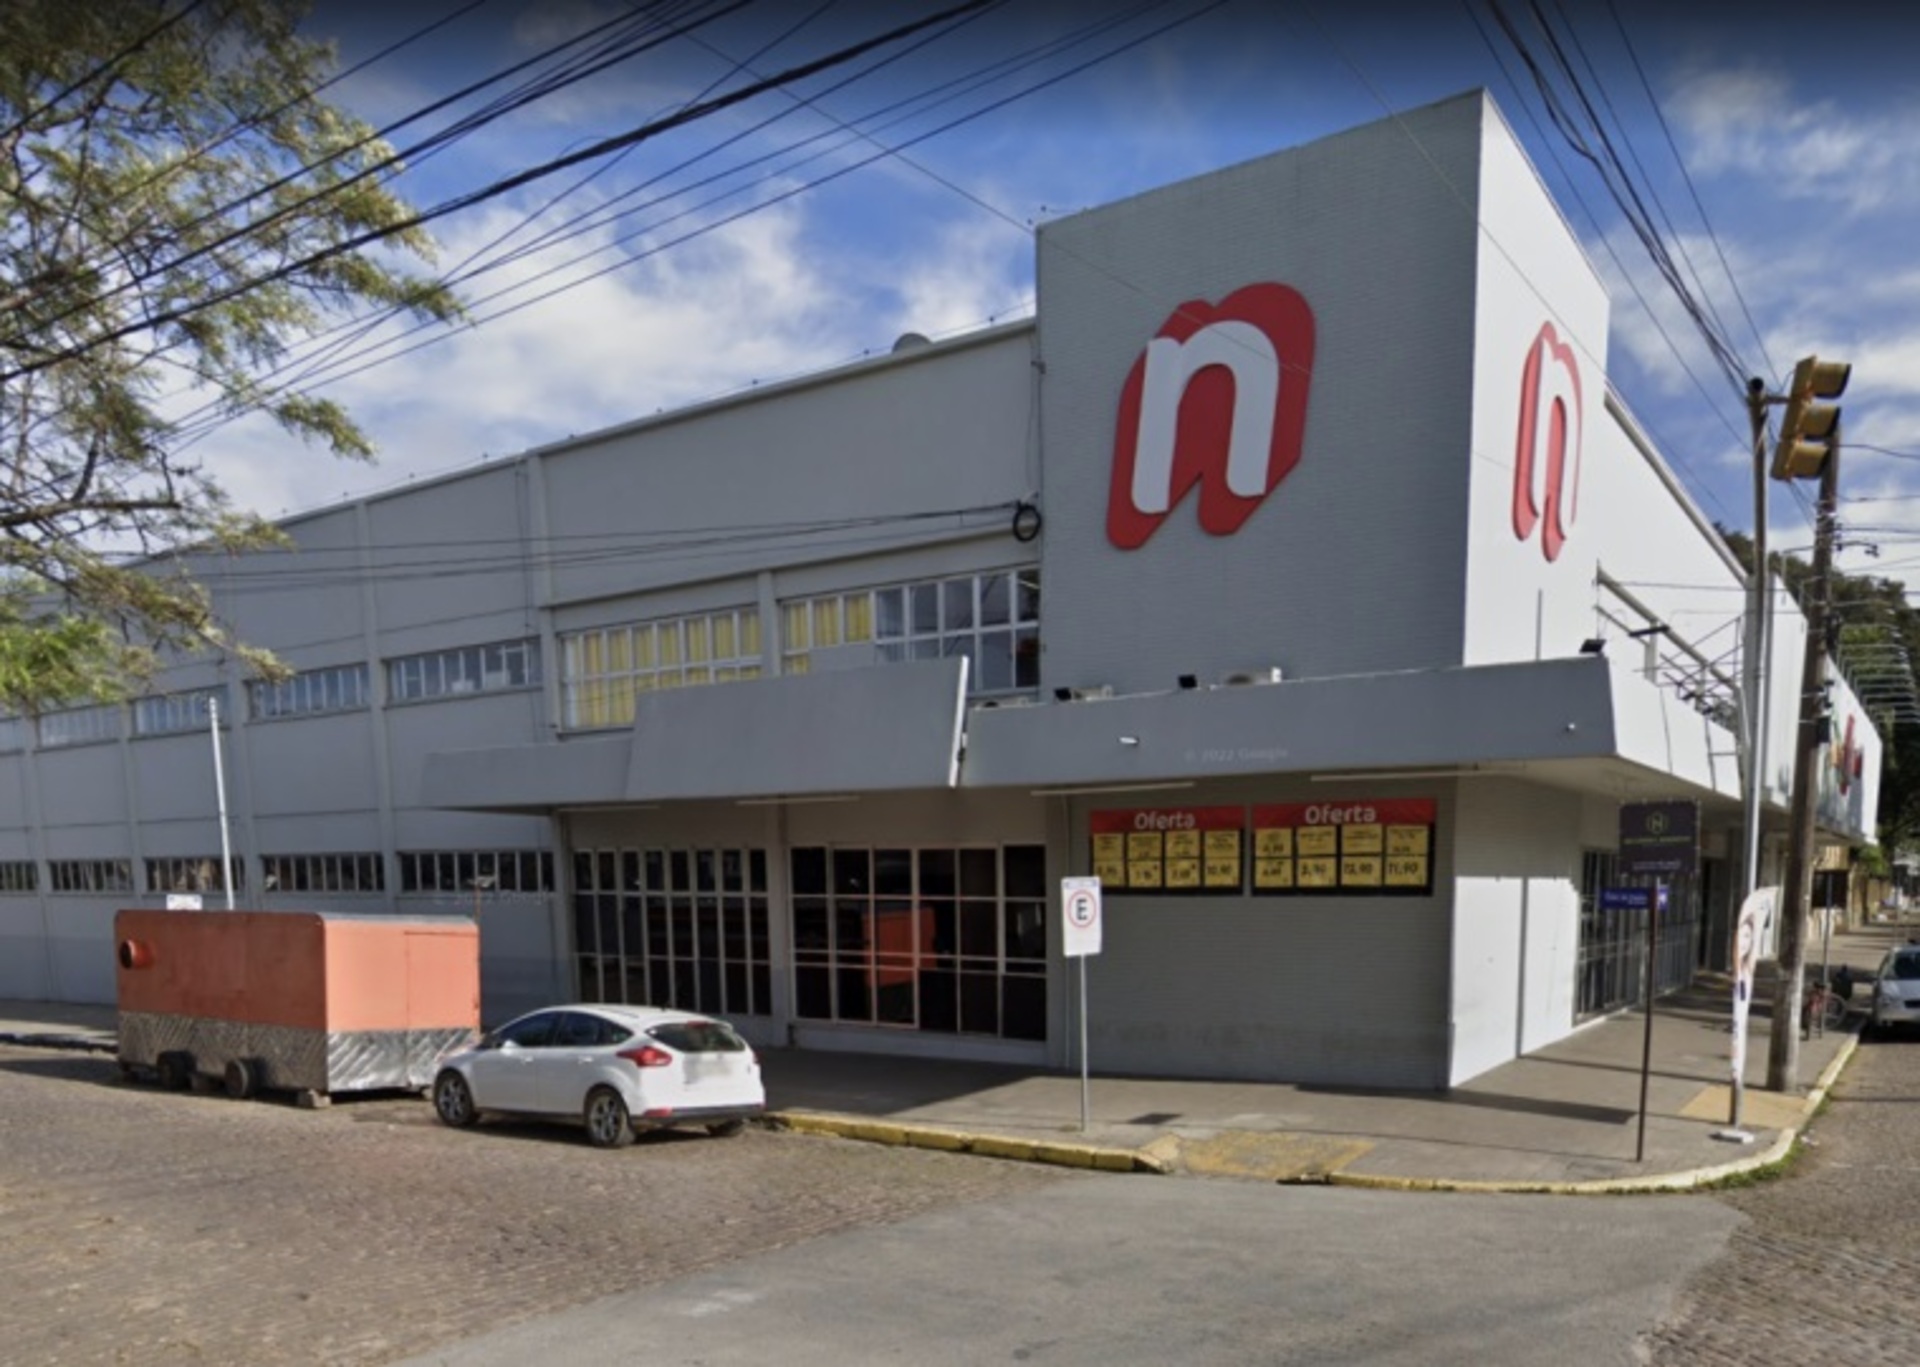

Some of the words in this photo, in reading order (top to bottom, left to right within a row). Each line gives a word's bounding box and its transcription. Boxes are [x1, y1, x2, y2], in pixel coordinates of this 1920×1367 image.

[1128, 314, 1284, 518] n
[1527, 332, 1581, 545] n
[1134, 810, 1196, 829] Oferta
[1305, 803, 1376, 824] Oferta
[1076, 898, 1088, 920] E
